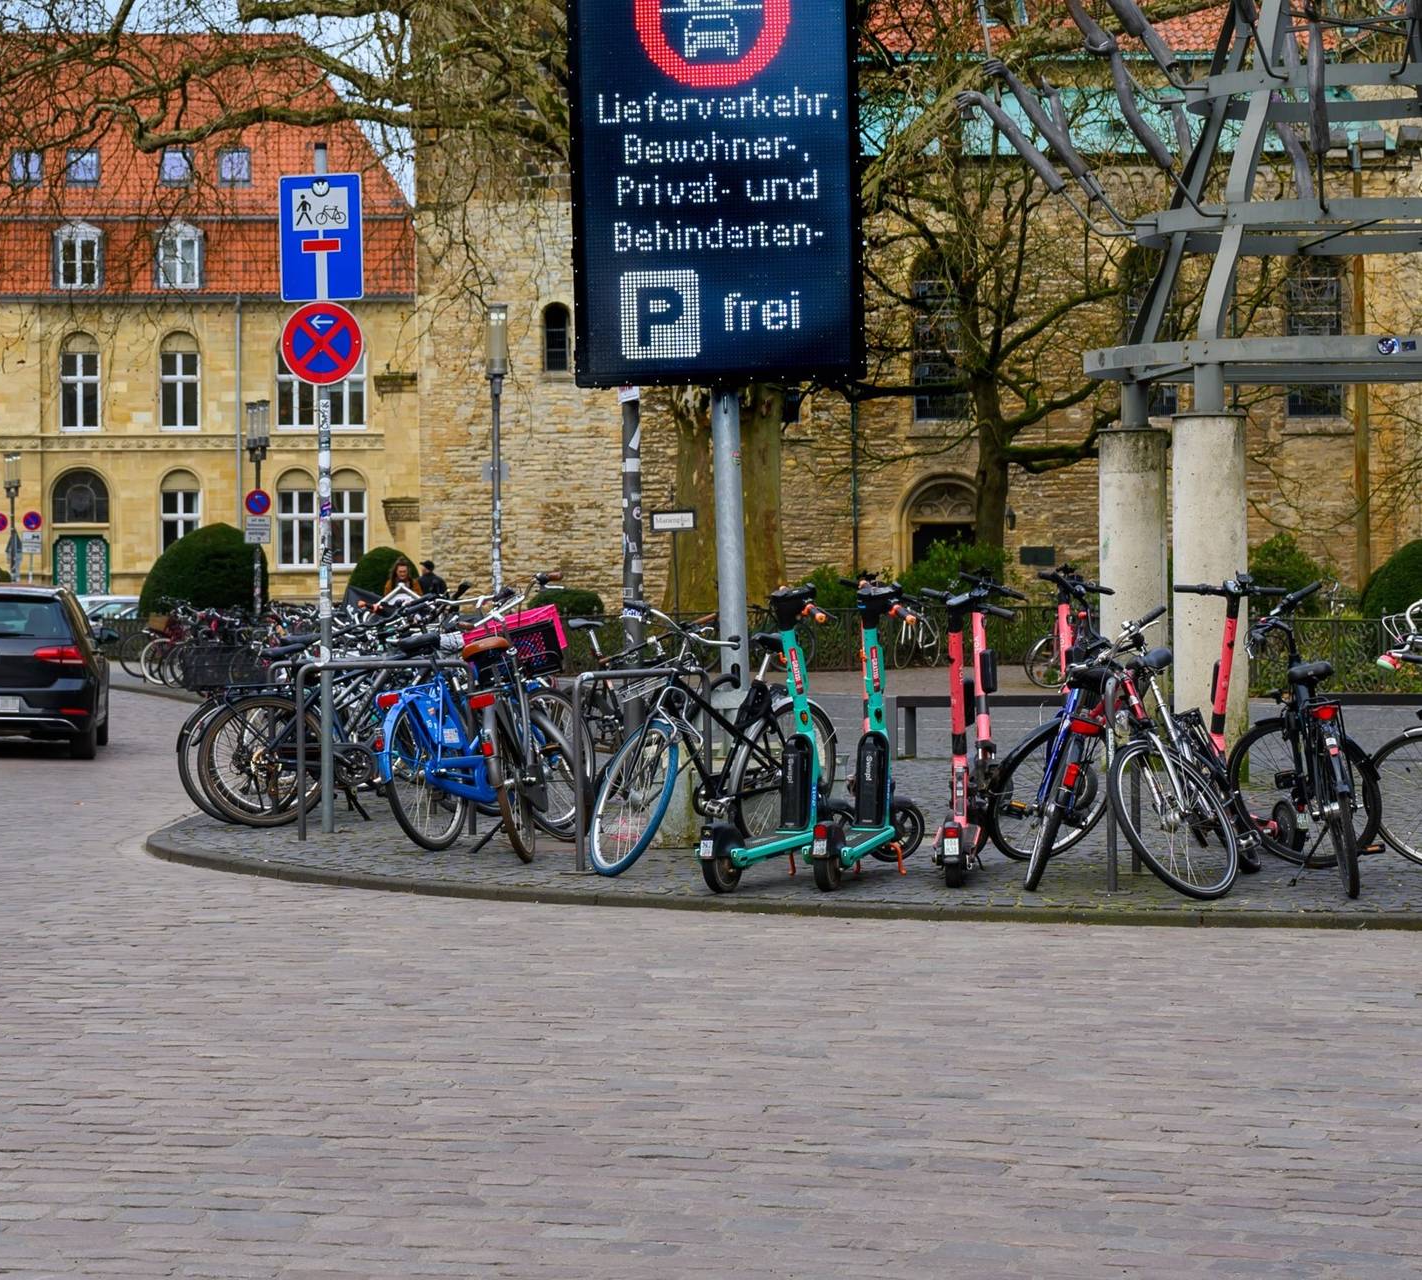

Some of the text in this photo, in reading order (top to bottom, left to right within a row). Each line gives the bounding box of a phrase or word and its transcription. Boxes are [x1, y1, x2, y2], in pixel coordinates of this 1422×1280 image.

[597, 87, 839, 125] Lieferverkehr,
[623, 131, 810, 165] Bewohner-,
[616, 169, 818, 206] Privat- und
[613, 219, 824, 253] Behinderten-
[633, 286, 801, 349] P frei
